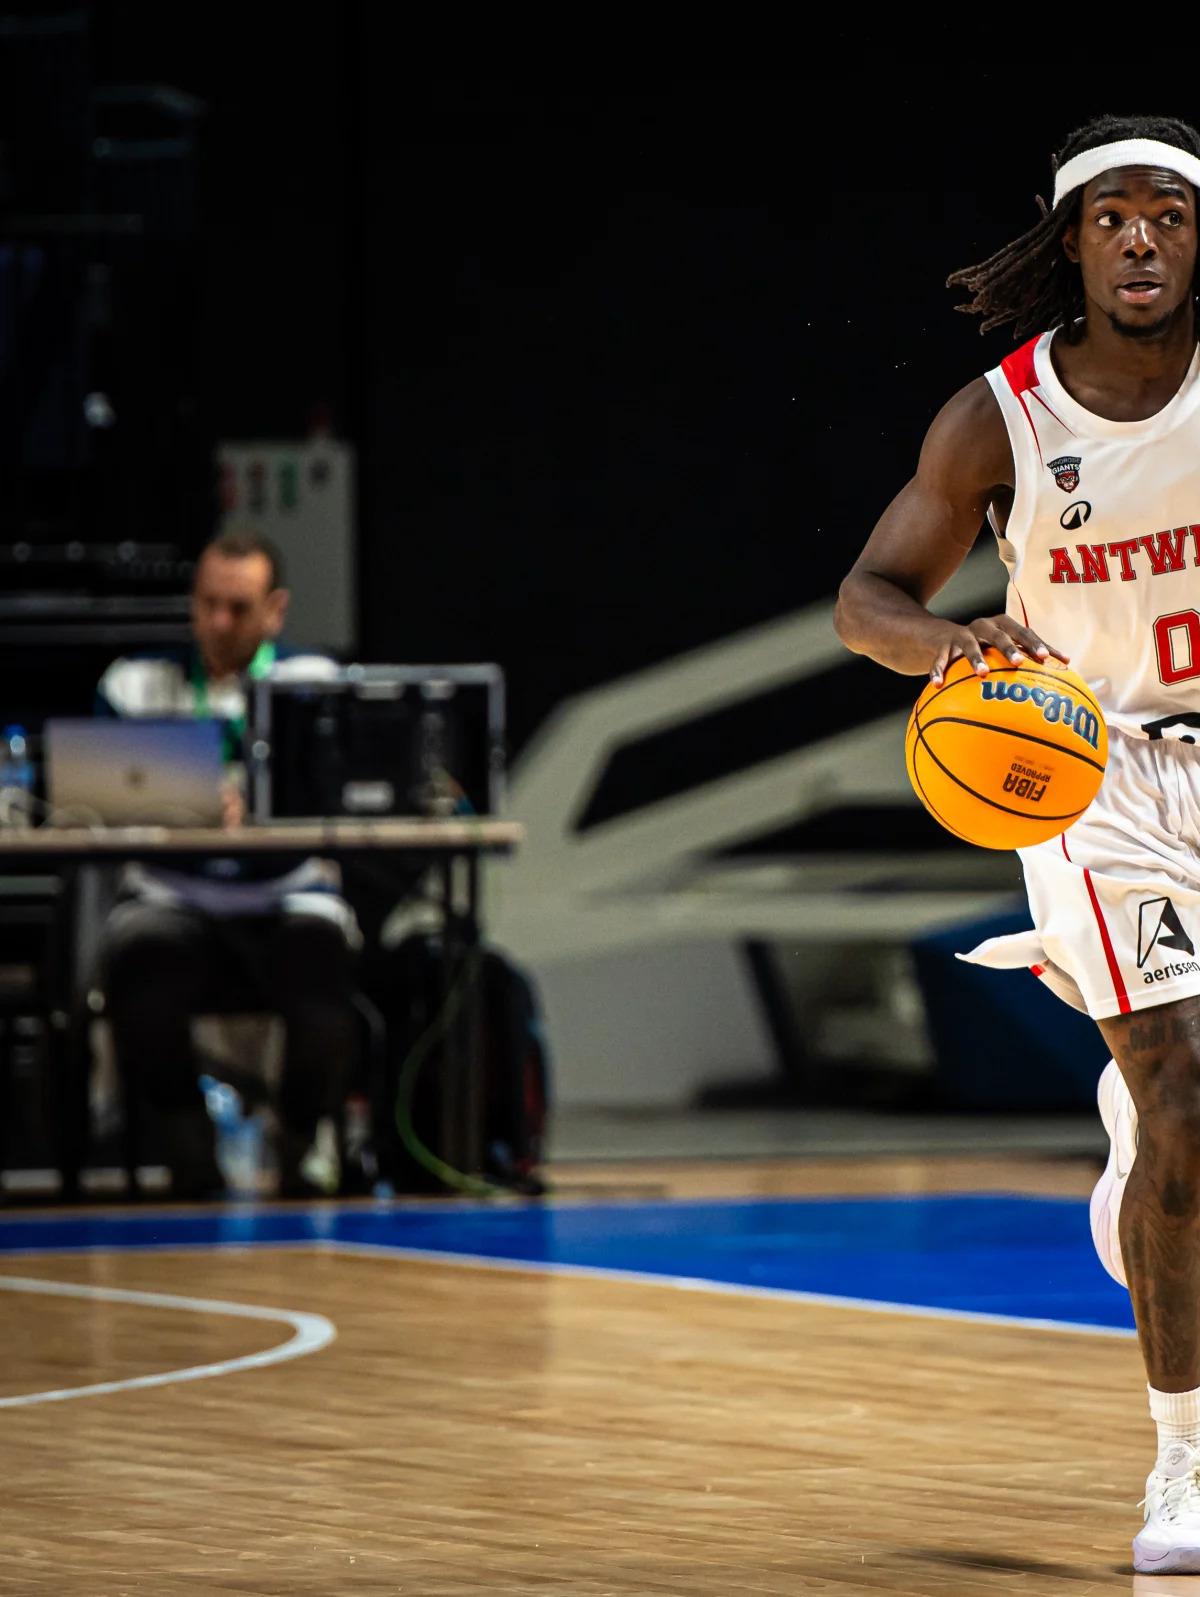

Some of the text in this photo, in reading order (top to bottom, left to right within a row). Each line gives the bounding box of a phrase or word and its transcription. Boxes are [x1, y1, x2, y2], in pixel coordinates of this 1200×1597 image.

[1051, 463, 1080, 475] GIANTS
[981, 681, 1099, 750] Wilson
[1011, 763, 1051, 783] APPROVED
[1002, 773, 1047, 801] FIBA
[1143, 962, 1200, 984] aertssen
